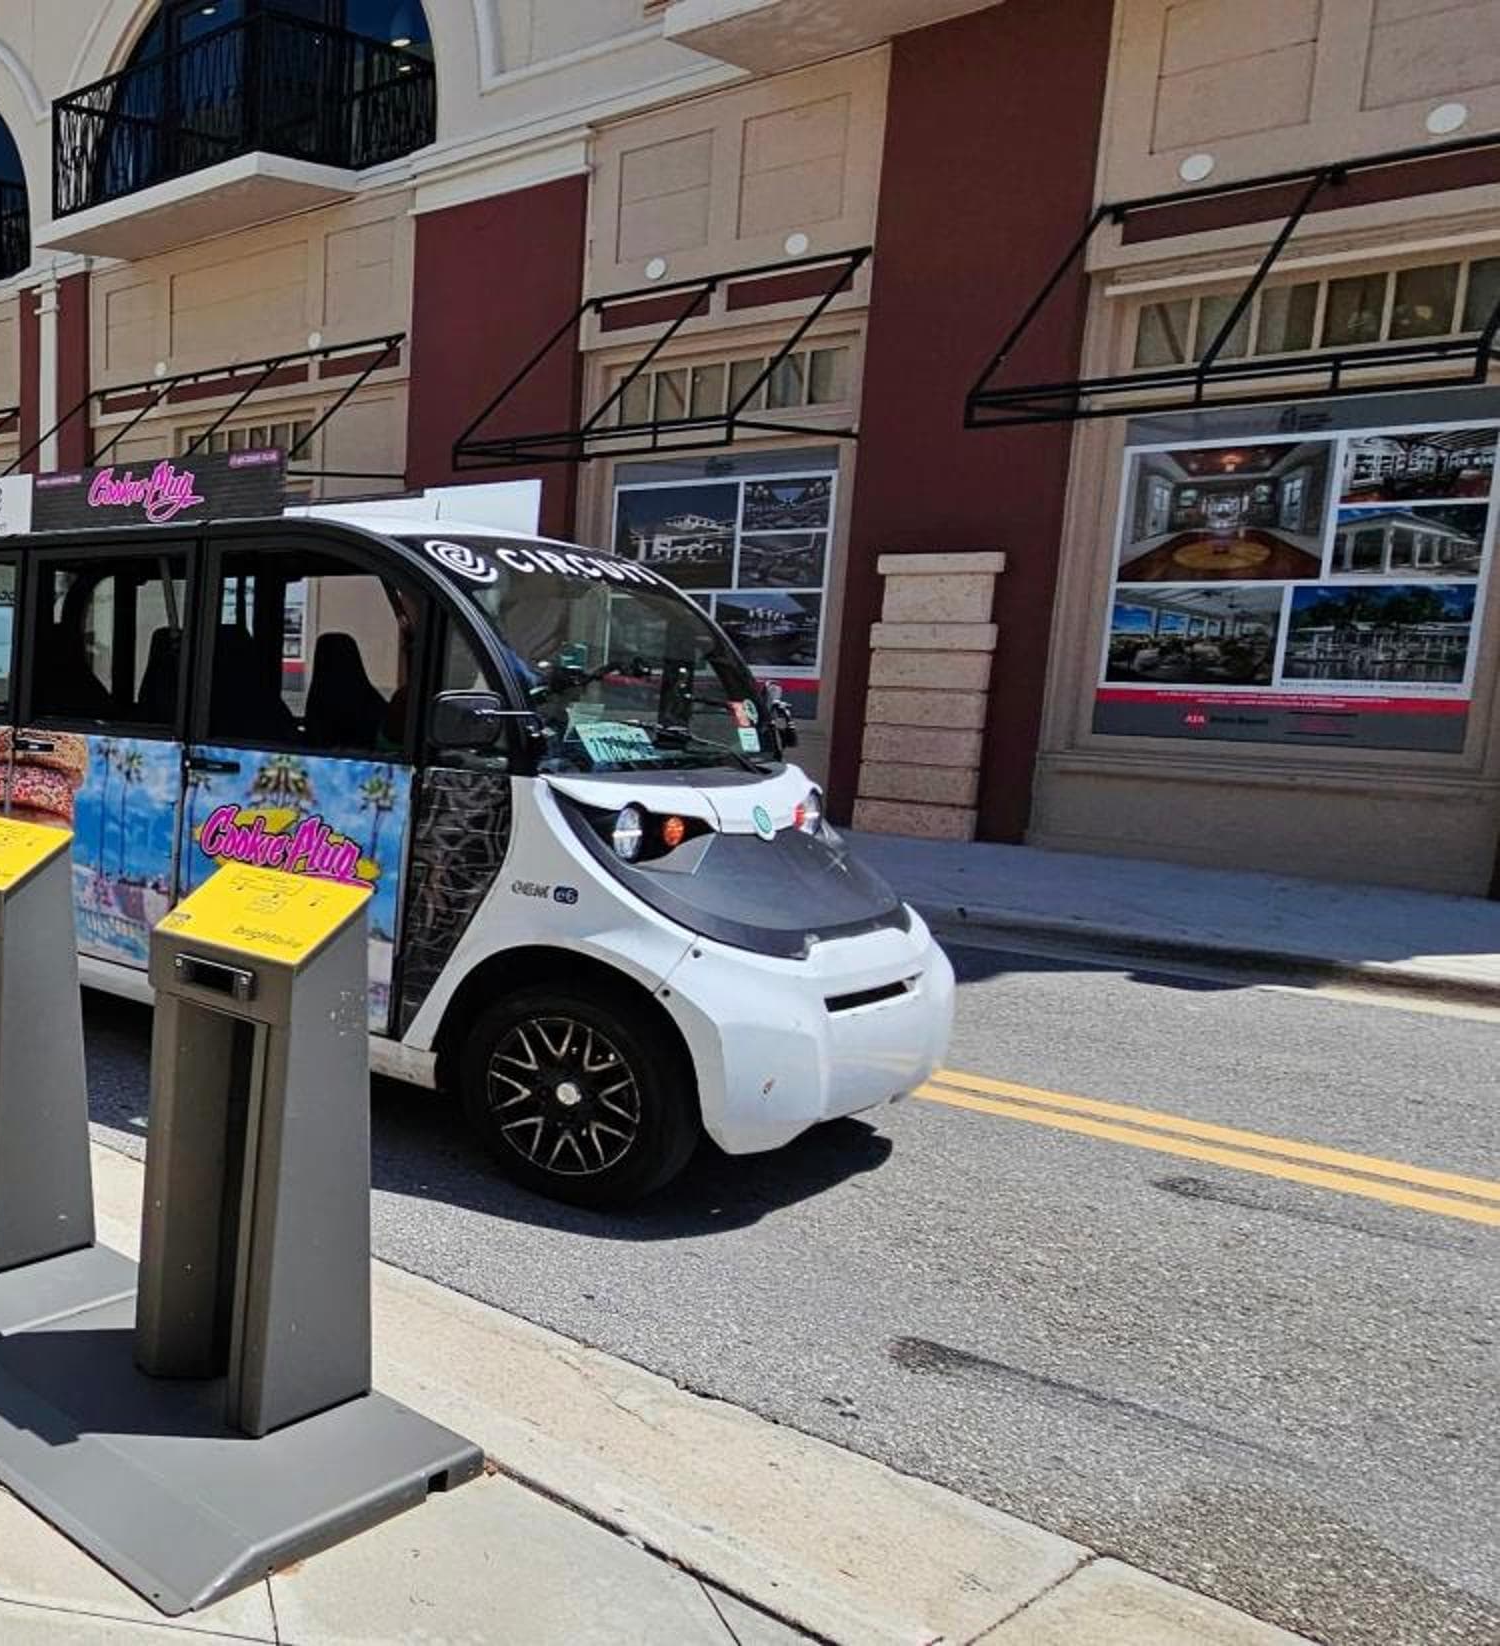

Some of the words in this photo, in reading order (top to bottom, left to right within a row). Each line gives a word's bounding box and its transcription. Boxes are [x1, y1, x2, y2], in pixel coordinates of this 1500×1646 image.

[88, 467, 151, 507] Cookie
[146, 459, 205, 523] Plug
[496, 549, 658, 585] CIRCUIT
[201, 804, 289, 867] Cookie
[281, 814, 376, 889] Plug
